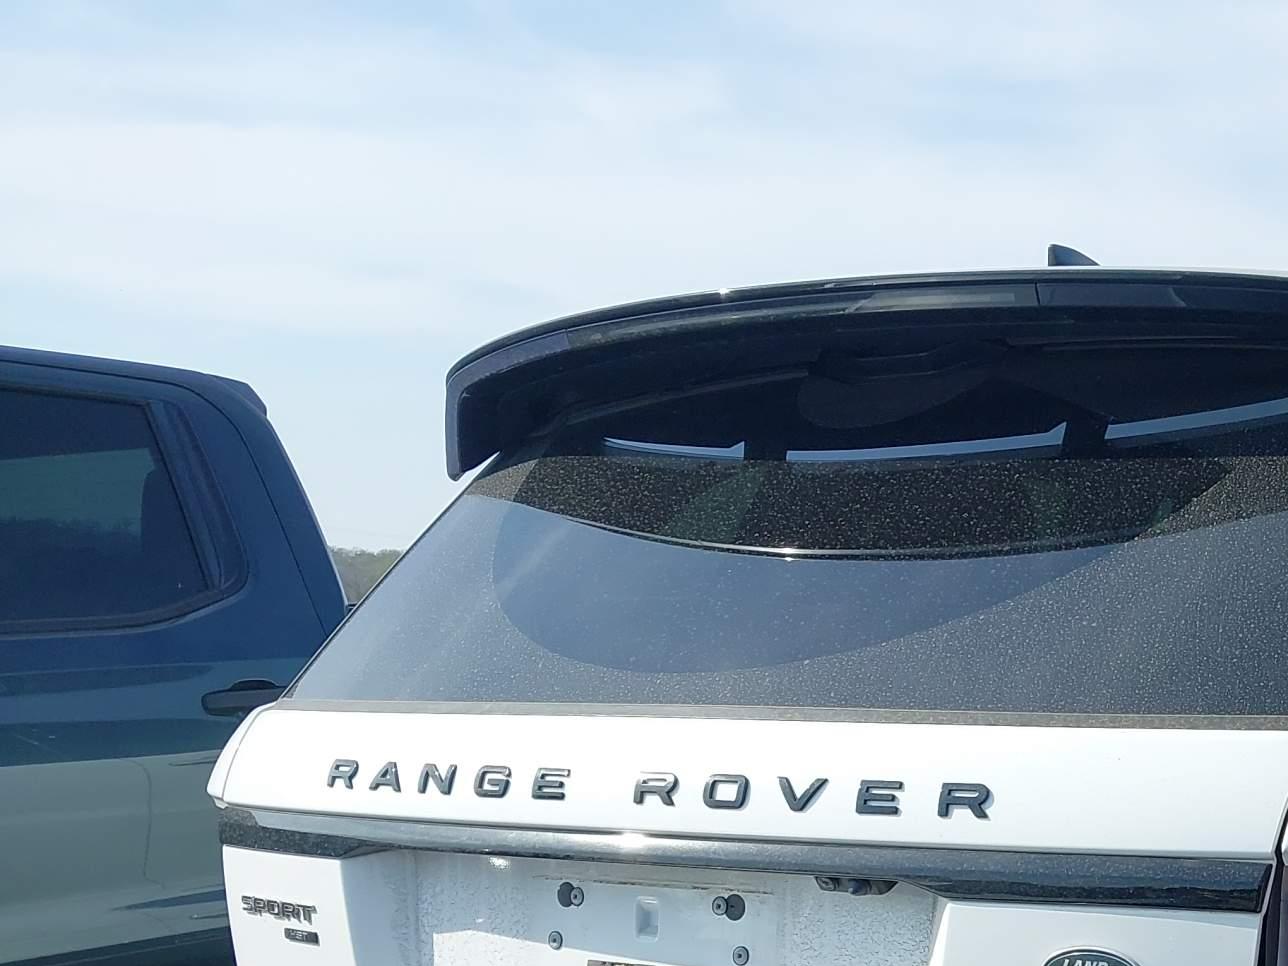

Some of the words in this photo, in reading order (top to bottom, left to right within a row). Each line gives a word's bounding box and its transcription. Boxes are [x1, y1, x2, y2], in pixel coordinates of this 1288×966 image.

[327, 758, 571, 801] RANGE
[633, 770, 995, 821] ROVER
[241, 895, 317, 926] SPORT
